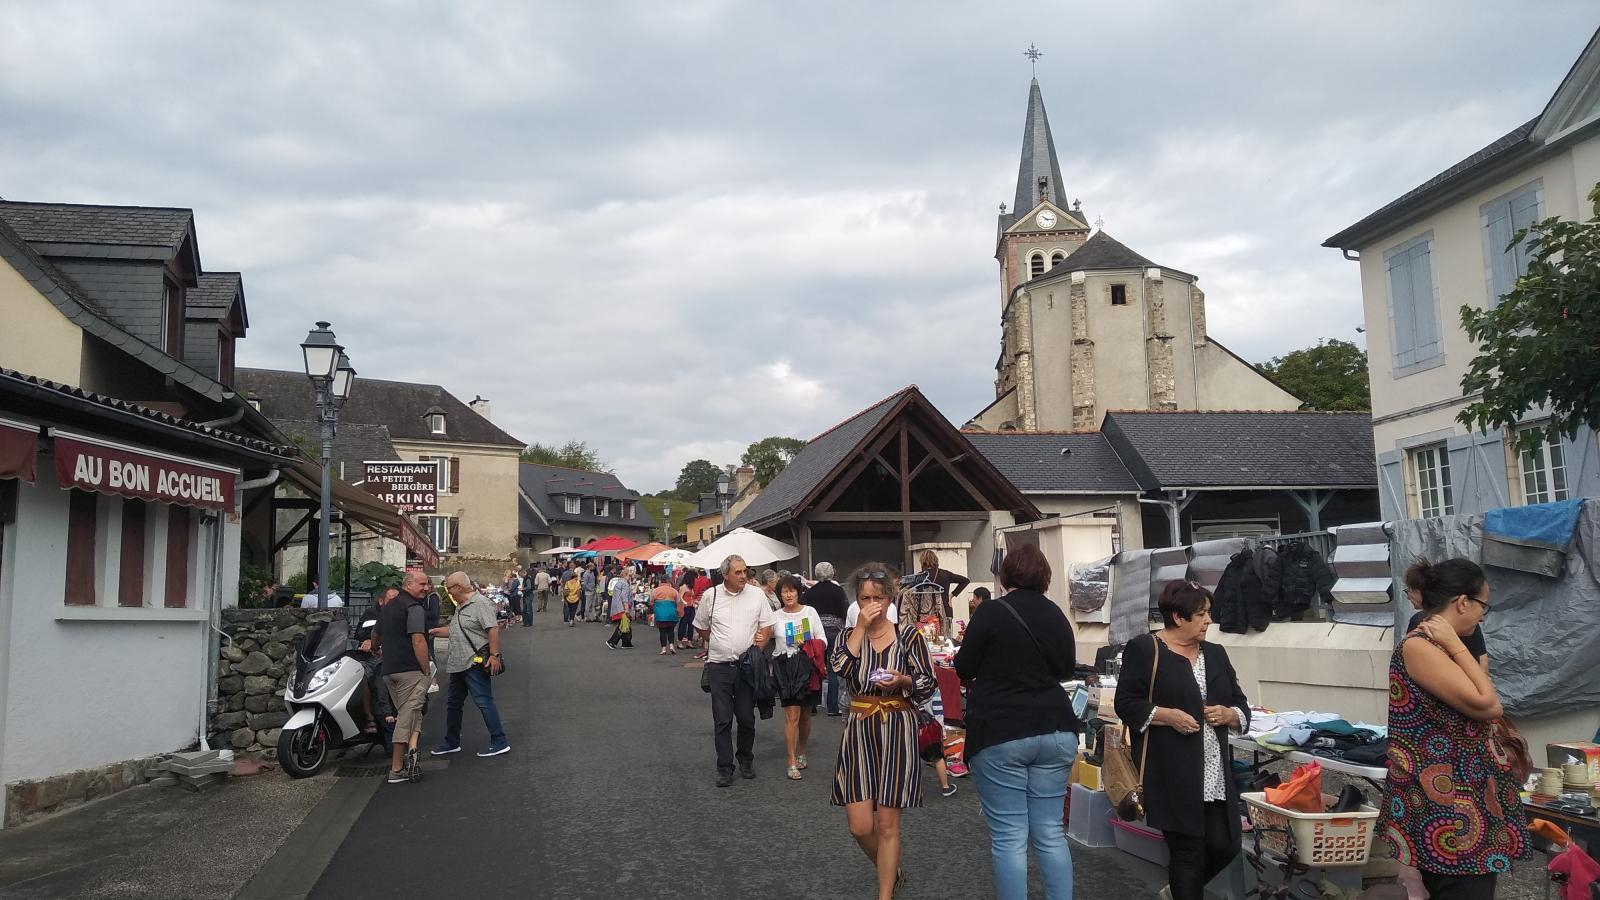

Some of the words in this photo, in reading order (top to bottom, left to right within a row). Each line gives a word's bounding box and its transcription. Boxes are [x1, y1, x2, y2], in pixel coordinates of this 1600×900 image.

[367, 465, 433, 473] RESTAURANT
[74, 454, 103, 485] AU
[109, 460, 150, 492] BON
[156, 468, 225, 503] ACCUEIL
[391, 482, 433, 490] BERGÈRE
[370, 493, 434, 503] ARKING
